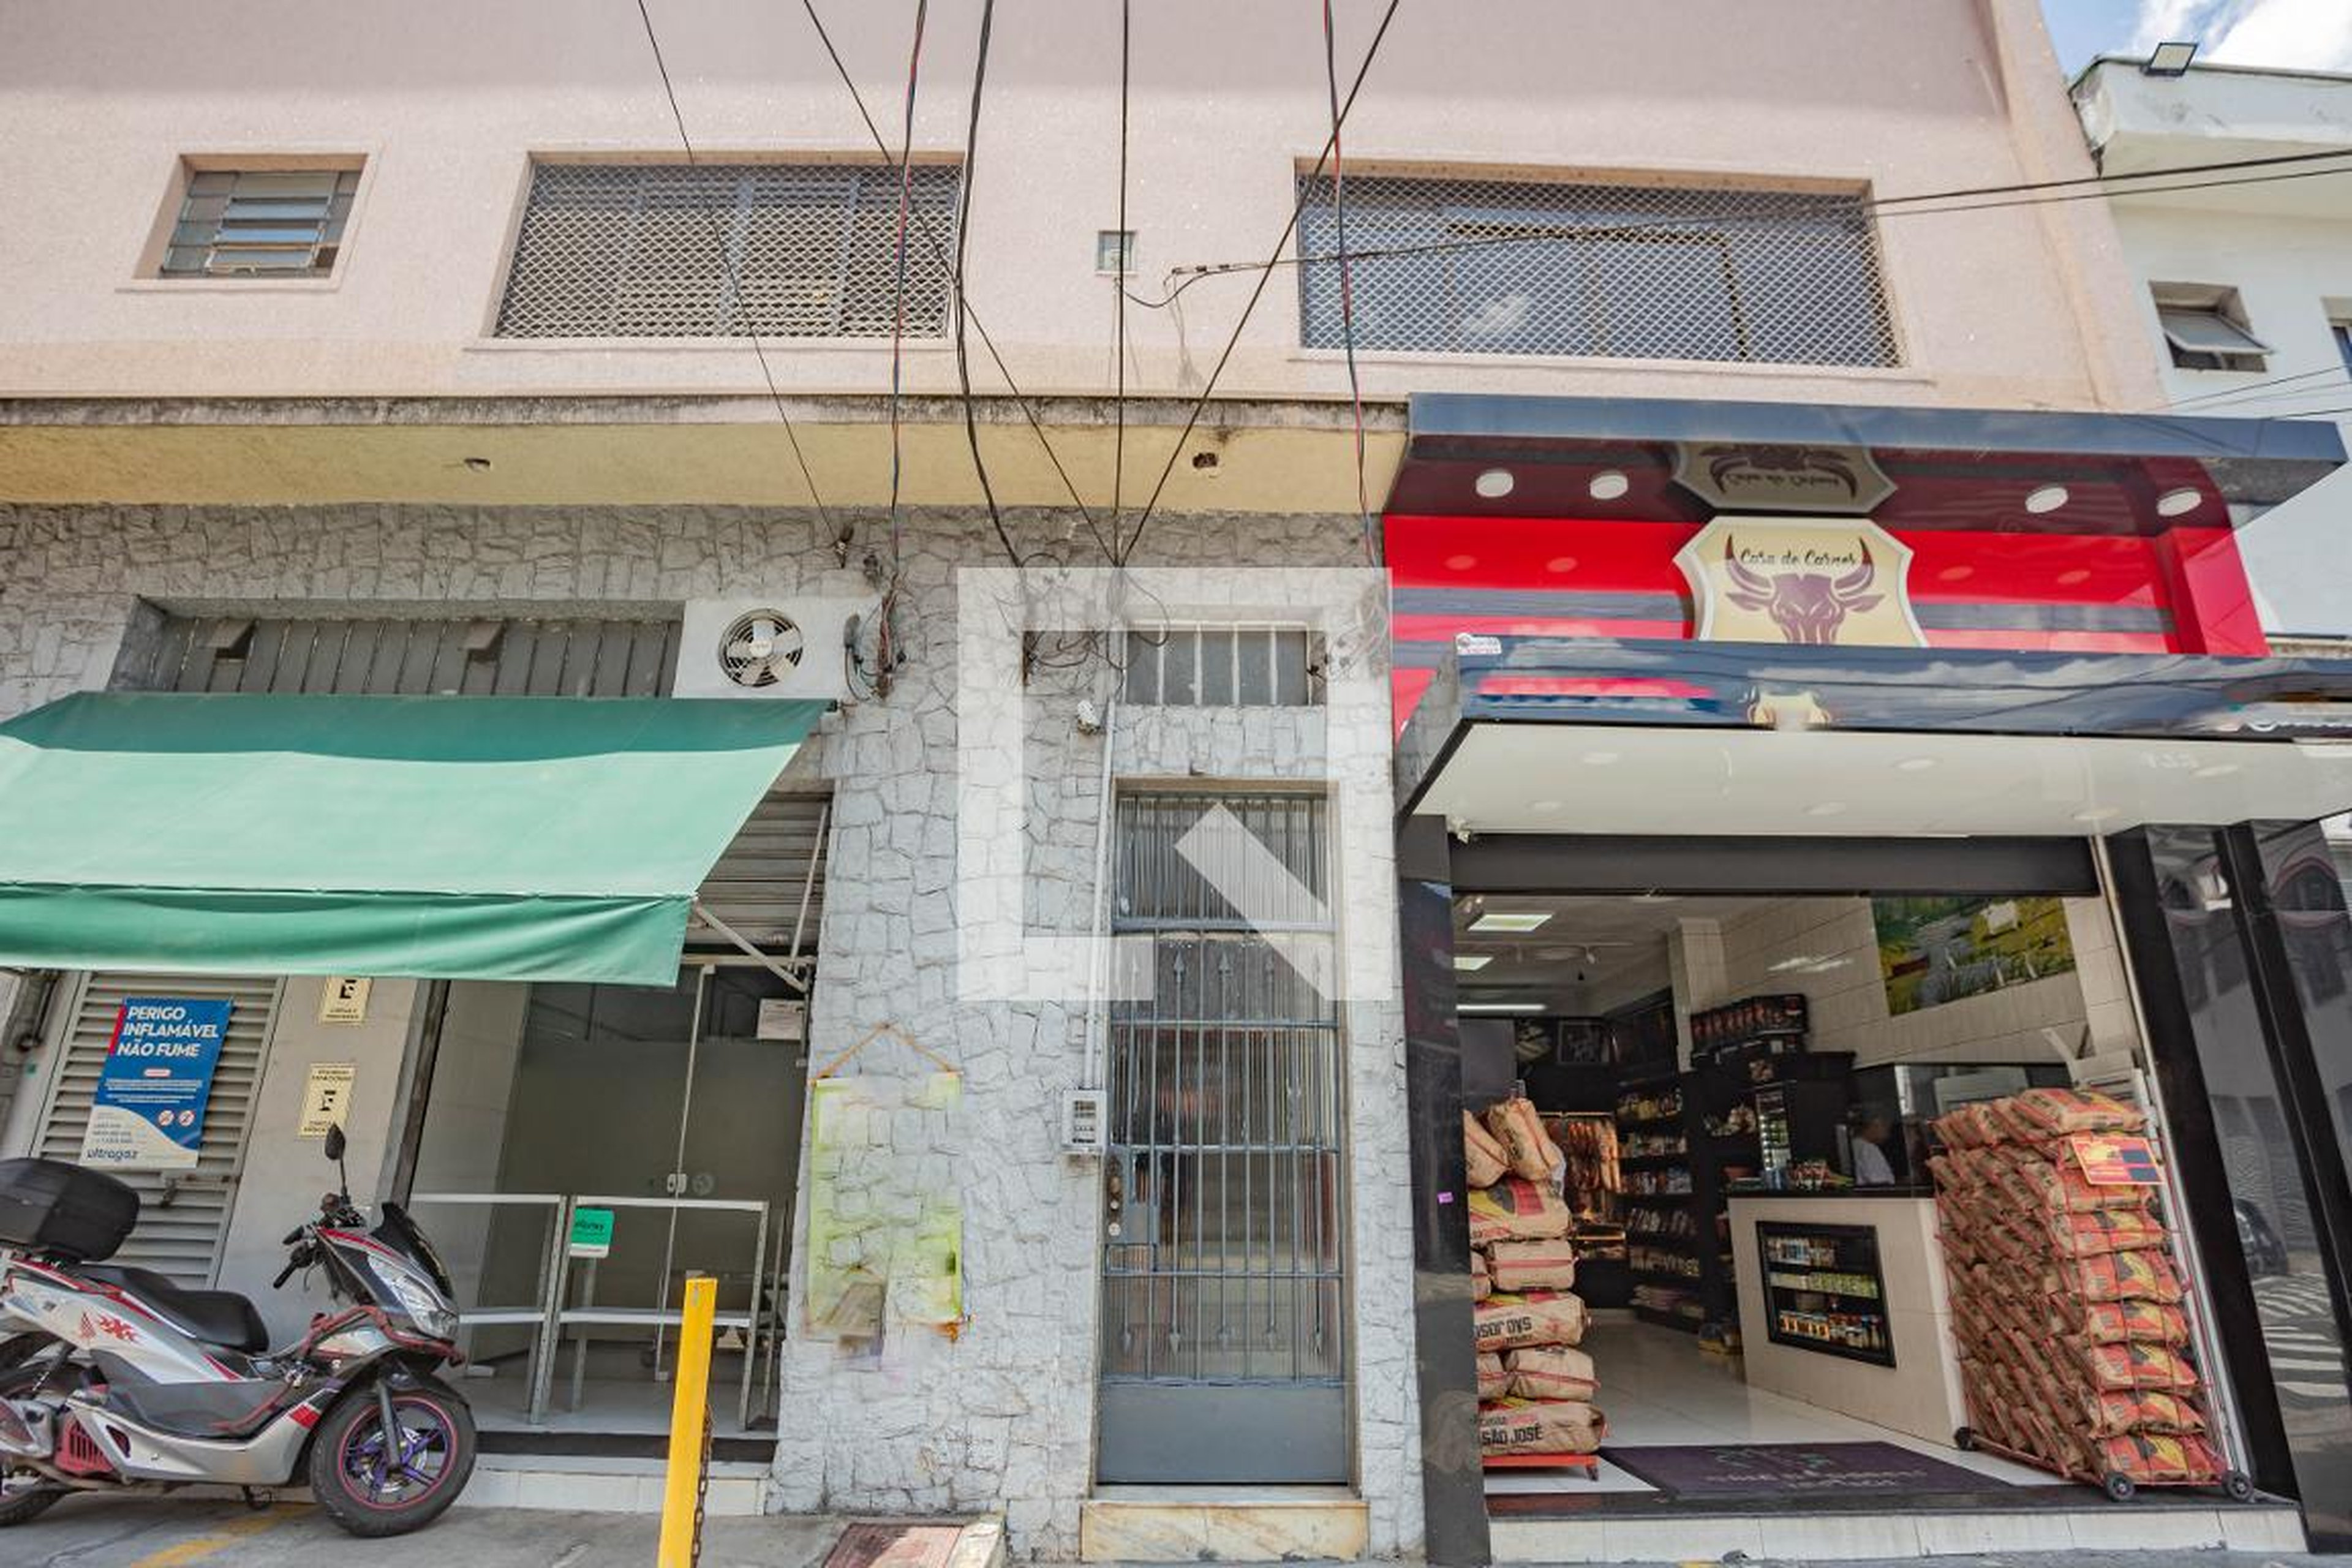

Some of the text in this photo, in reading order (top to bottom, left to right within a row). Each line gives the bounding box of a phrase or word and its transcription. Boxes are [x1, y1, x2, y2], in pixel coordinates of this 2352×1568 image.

[1740, 548, 1775, 564] Casa
[1782, 549, 1798, 564] de
[127, 1006, 186, 1020] PERIGO
[122, 1019, 219, 1038] INFLAMÁVEL
[116, 1038, 201, 1057] NÃO FUME
[87, 1148, 138, 1162] ultragaz
[1510, 1422, 1544, 1444] JOSÉ
